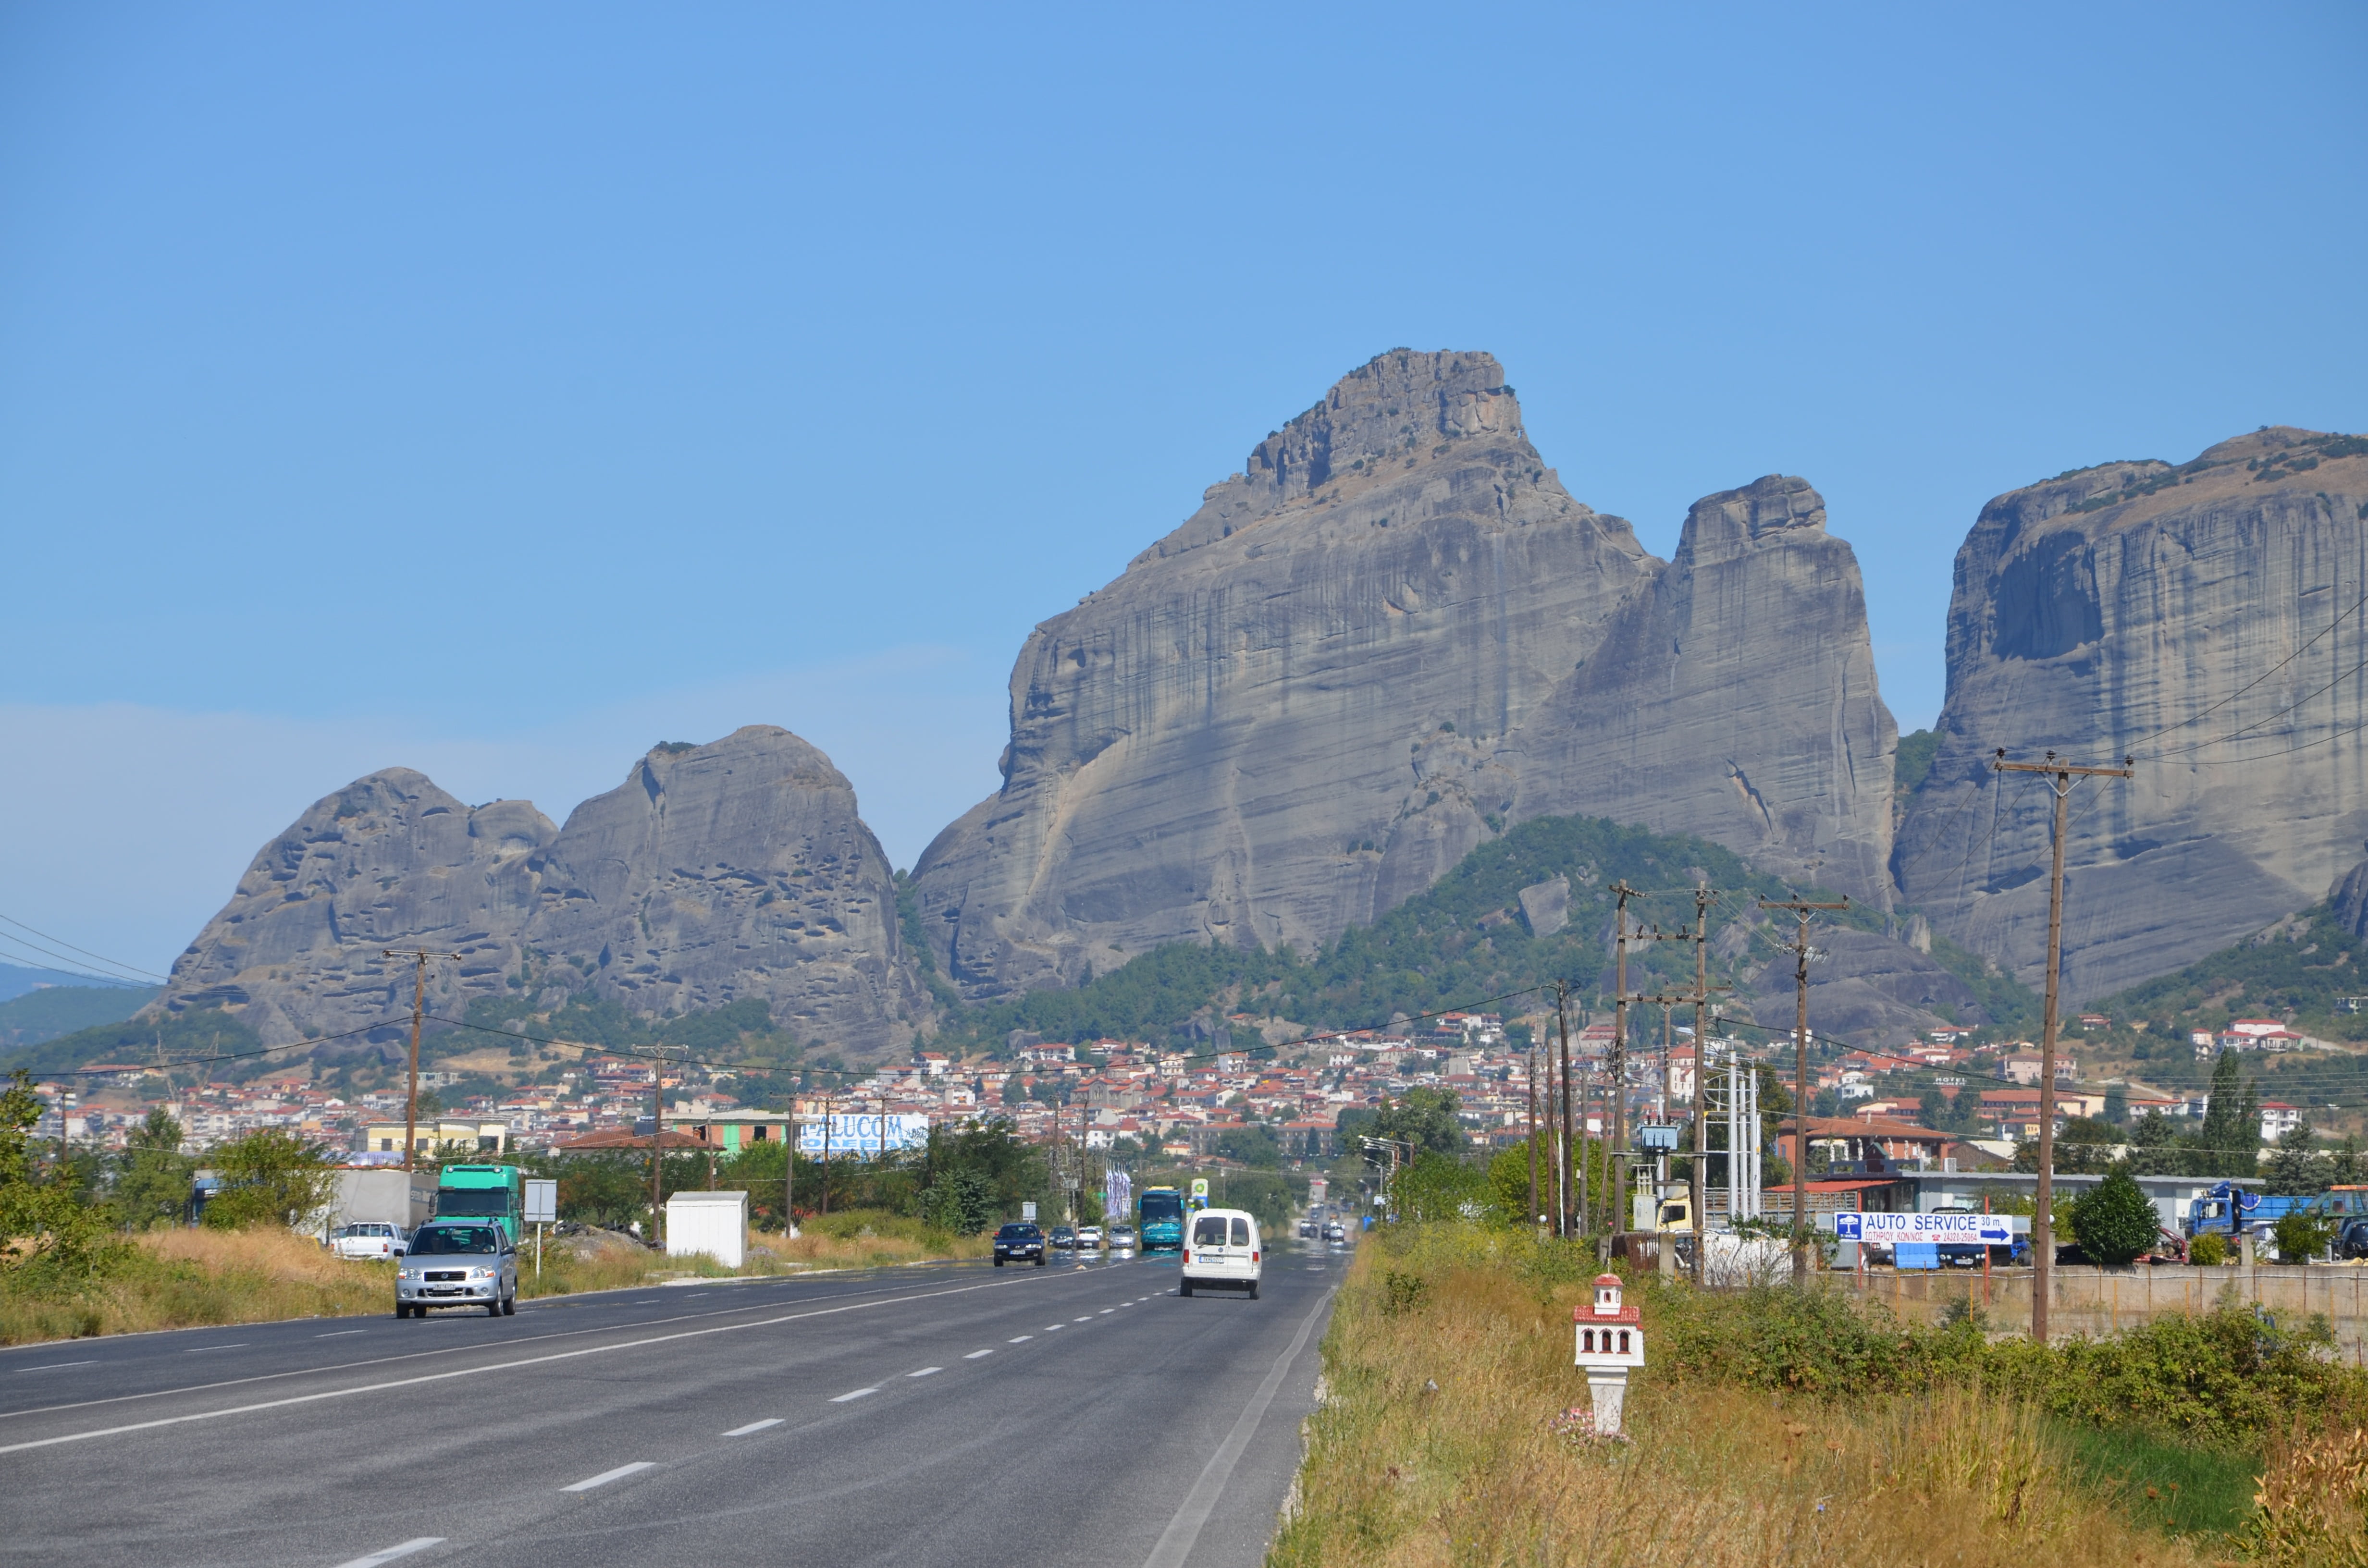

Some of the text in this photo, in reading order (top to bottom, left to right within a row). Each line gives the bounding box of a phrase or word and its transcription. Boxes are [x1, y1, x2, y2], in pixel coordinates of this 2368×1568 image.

[1866, 1215, 1976, 1230] AUTO SERVICE
[1981, 1217, 1990, 1226] 30
[1865, 1231, 1893, 1241] ΣΩΤΗΡΙΟΥ
[1897, 1231, 1923, 1241] ΚΩΝ/ΝΟΣ
[1943, 1232, 1977, 1242] 24320-25064
